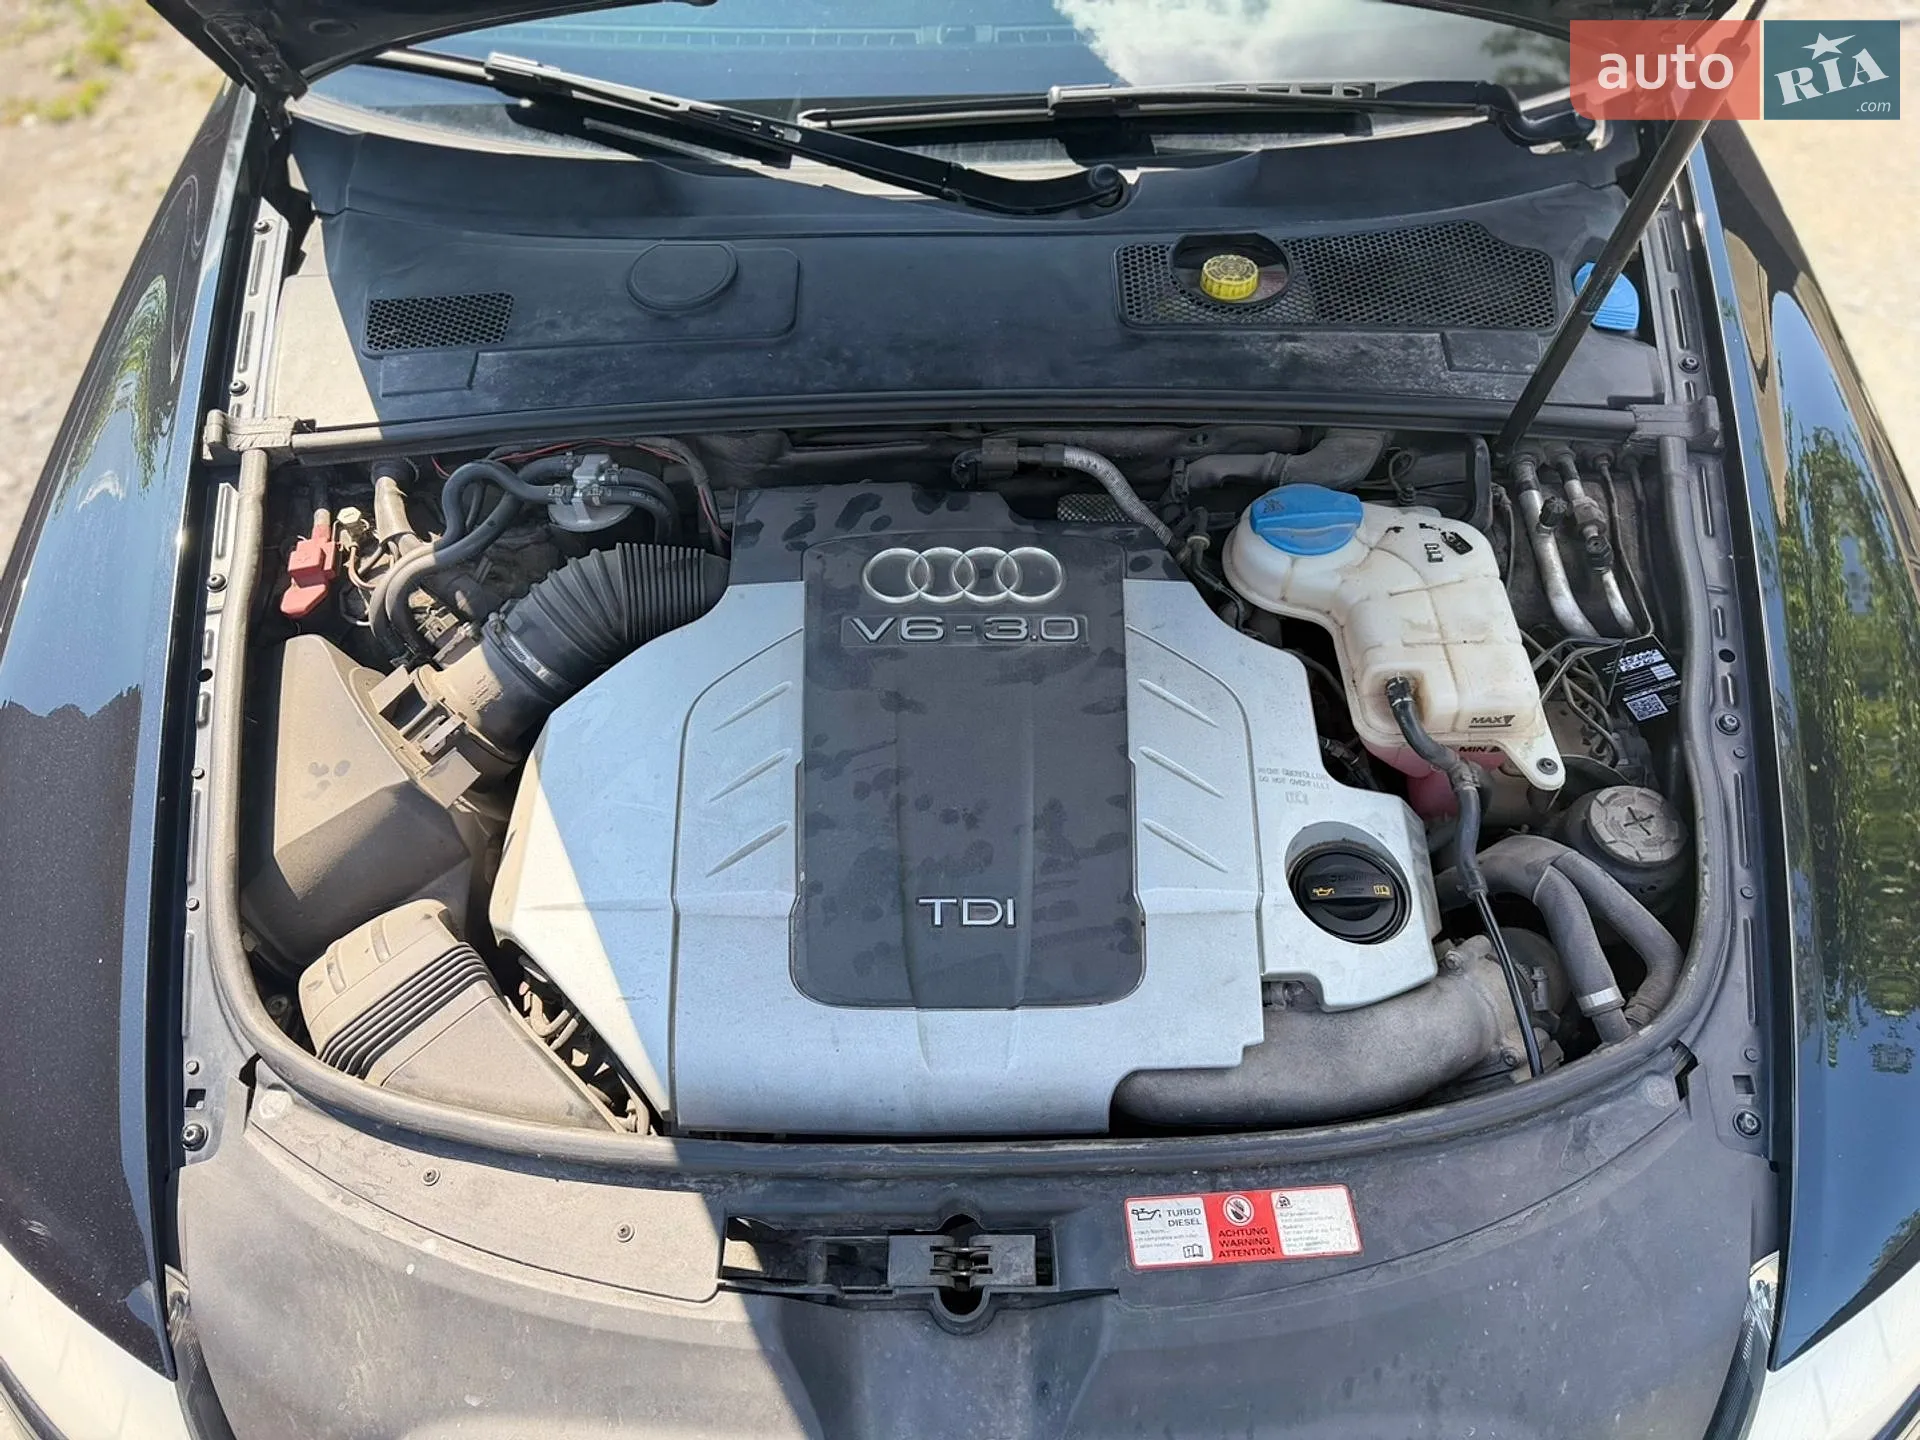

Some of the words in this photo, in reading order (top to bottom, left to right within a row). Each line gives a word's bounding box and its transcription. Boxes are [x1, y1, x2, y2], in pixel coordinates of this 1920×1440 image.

[851, 615, 944, 643] V6
[983, 616, 1079, 642] 3.0
[1470, 716, 1502, 724] MAX
[917, 897, 1016, 927] TDI
[1167, 1207, 1201, 1218] TURBO
[1167, 1217, 1202, 1227] DIESEL
[1218, 1226, 1268, 1238] ACHTUNG
[1219, 1237, 1271, 1248] WARNING
[1218, 1247, 1276, 1258] ATTENTION
